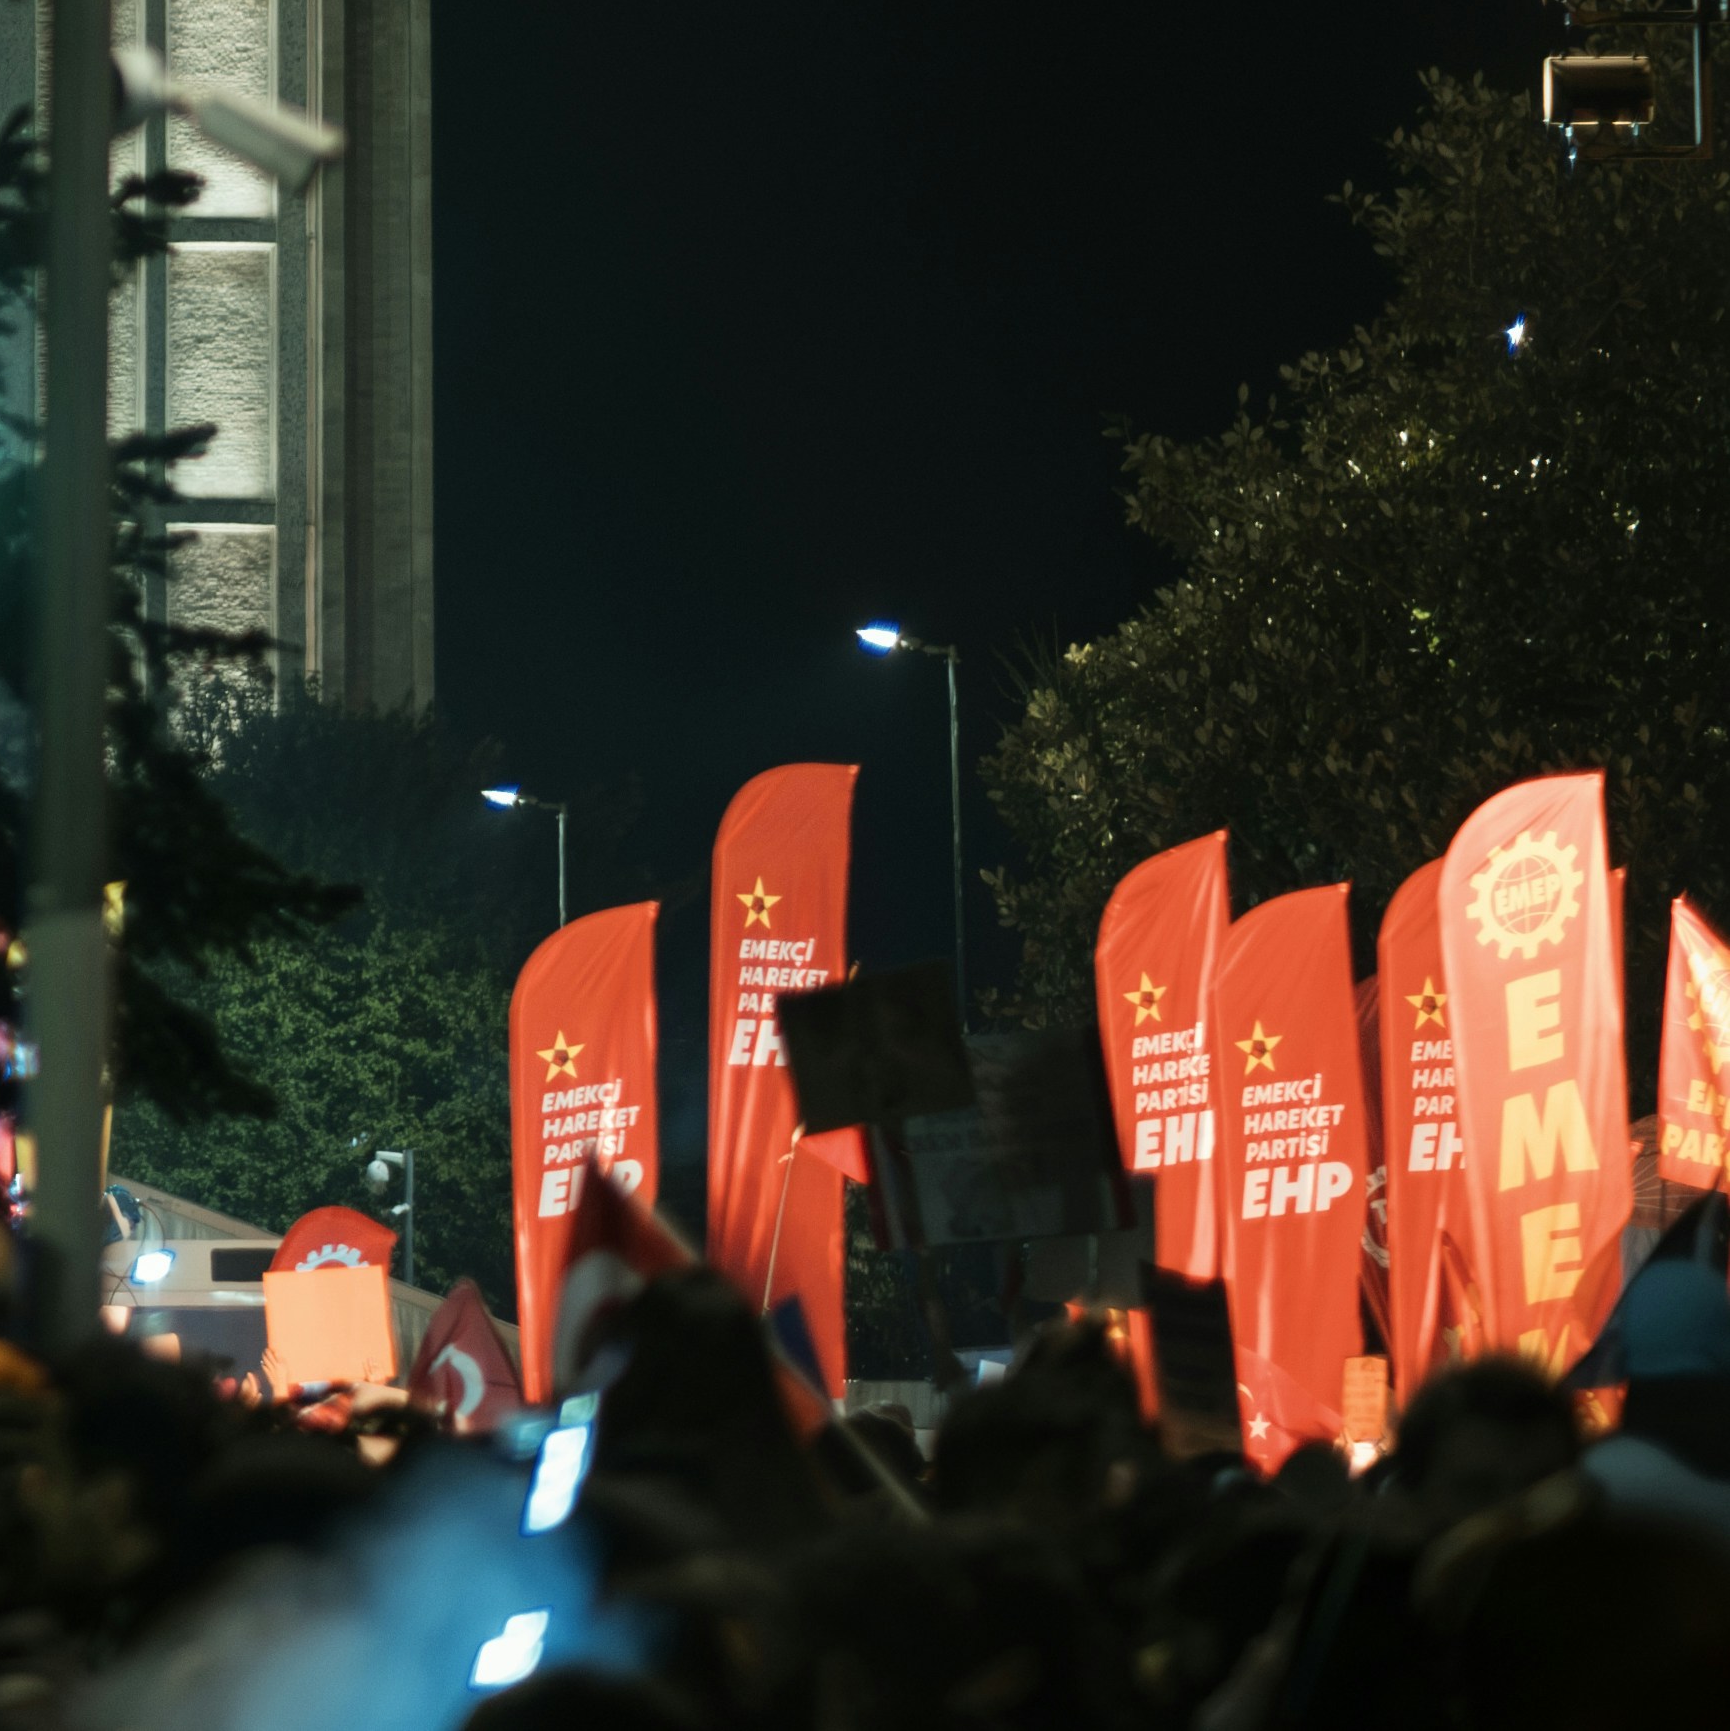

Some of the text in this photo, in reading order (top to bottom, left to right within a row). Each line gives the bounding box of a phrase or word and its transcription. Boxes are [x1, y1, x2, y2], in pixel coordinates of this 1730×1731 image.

[1493, 873, 1563, 918] EMEP
[738, 938, 816, 967] EMEKÇİ
[738, 966, 829, 989] HAREKET
[737, 992, 777, 1013] PAR
[727, 1018, 789, 1067] EH
[1132, 1022, 1203, 1059] EMEKÇİ
[1410, 1039, 1453, 1062] EME
[1132, 1054, 1211, 1086] HAREKE
[1412, 1067, 1457, 1089] HAR
[541, 1078, 623, 1114] EMEKÇİ
[1241, 1073, 1322, 1107] EMEKÇİ
[1413, 1094, 1455, 1118] PAR
[542, 1105, 641, 1140] HAREKET
[1243, 1104, 1345, 1136] HAREKET
[1245, 1129, 1329, 1163] PARTİSİ
[1407, 1121, 1467, 1173] EH
[1241, 1161, 1354, 1220] EHP
